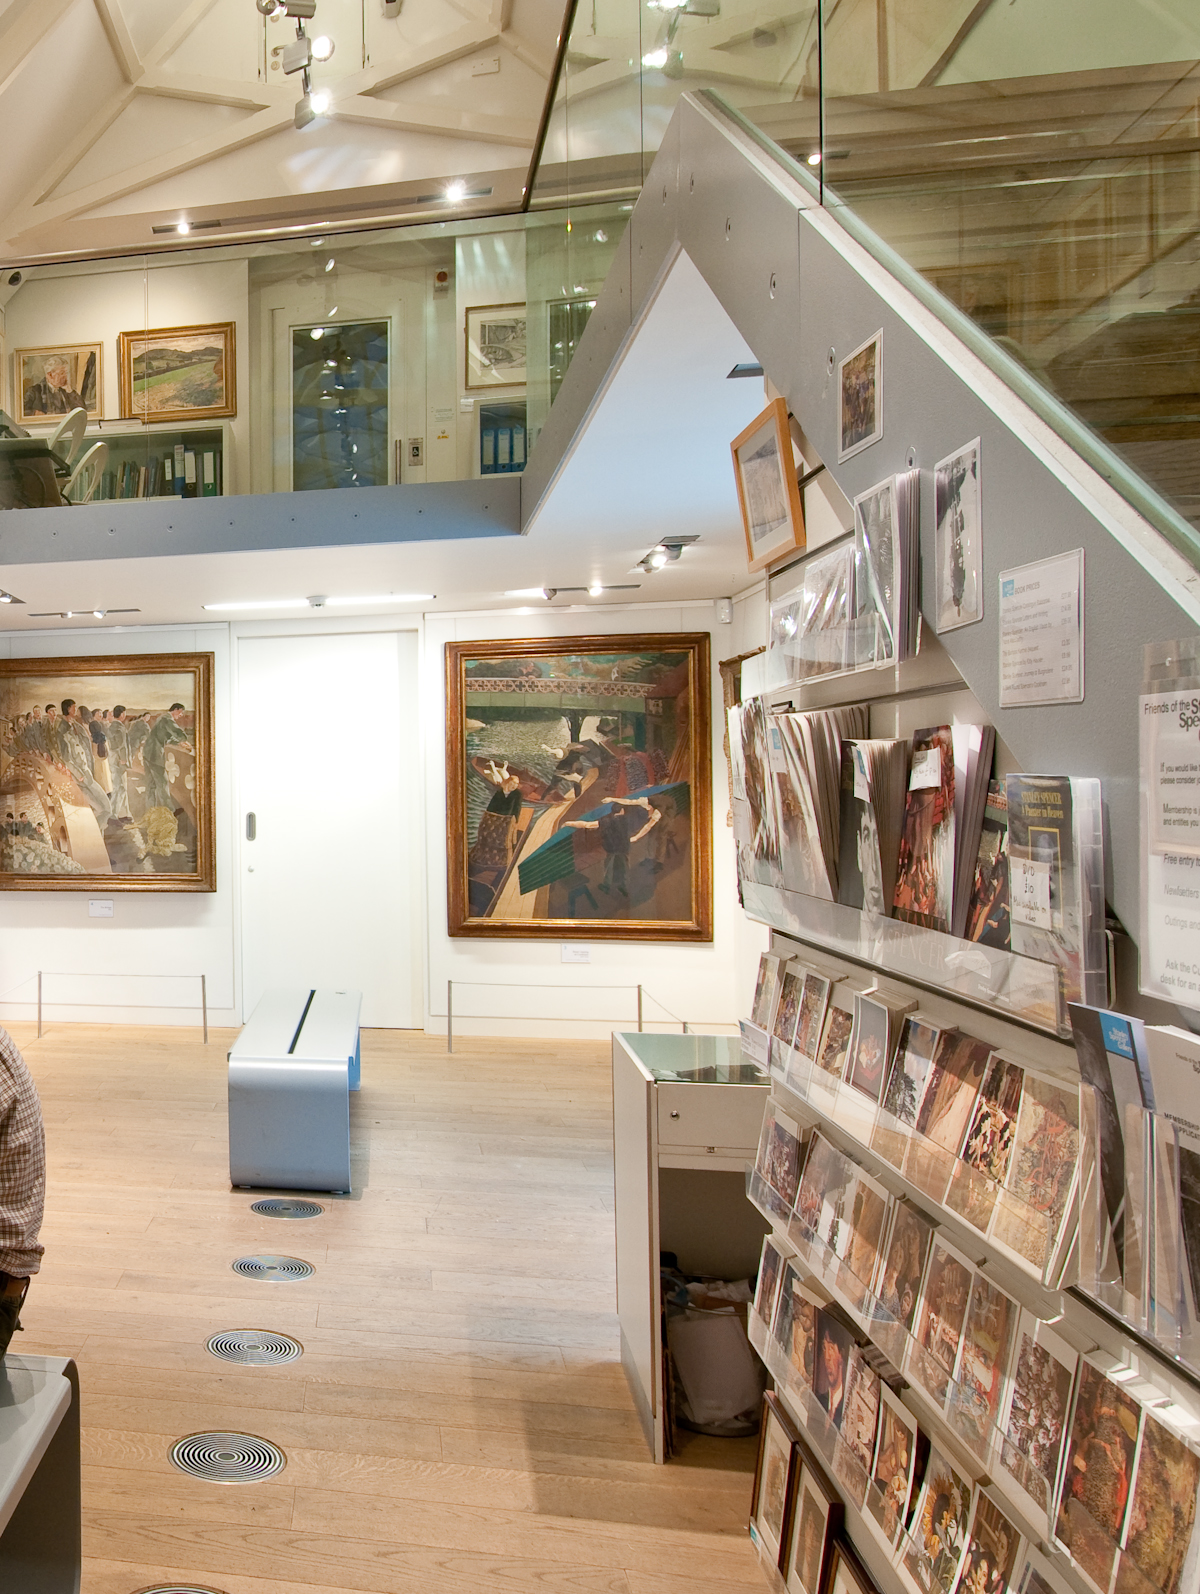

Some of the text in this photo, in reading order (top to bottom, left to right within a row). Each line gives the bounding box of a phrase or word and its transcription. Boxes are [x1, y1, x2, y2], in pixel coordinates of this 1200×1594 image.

[1015, 586, 1026, 596] BOOK
[1026, 581, 1041, 592] PRICES
[1144, 698, 1200, 715] Friends of the S
[1160, 762, 1165, 772] If
[1166, 766, 1175, 774] you
[1175, 764, 1189, 772] would
[1189, 764, 1198, 772] like
[1160, 777, 1176, 785] please
[1176, 776, 1196, 784] consider
[1021, 791, 1063, 804] STANLEY SPENCER
[1163, 803, 1192, 815] Membership
[1190, 820, 1199, 828] you
[1163, 853, 1177, 865] Free
[1179, 856, 1195, 869] entry
[1165, 914, 1188, 930] Outings
[885, 929, 946, 972] SPENCER
[1165, 959, 1178, 970] Ask
[1180, 961, 1191, 973] the
[1160, 973, 1176, 986] desk
[1177, 976, 1187, 988] for
[1188, 981, 1197, 990] an
[1164, 1111, 1199, 1131] MEMBERSHIP
